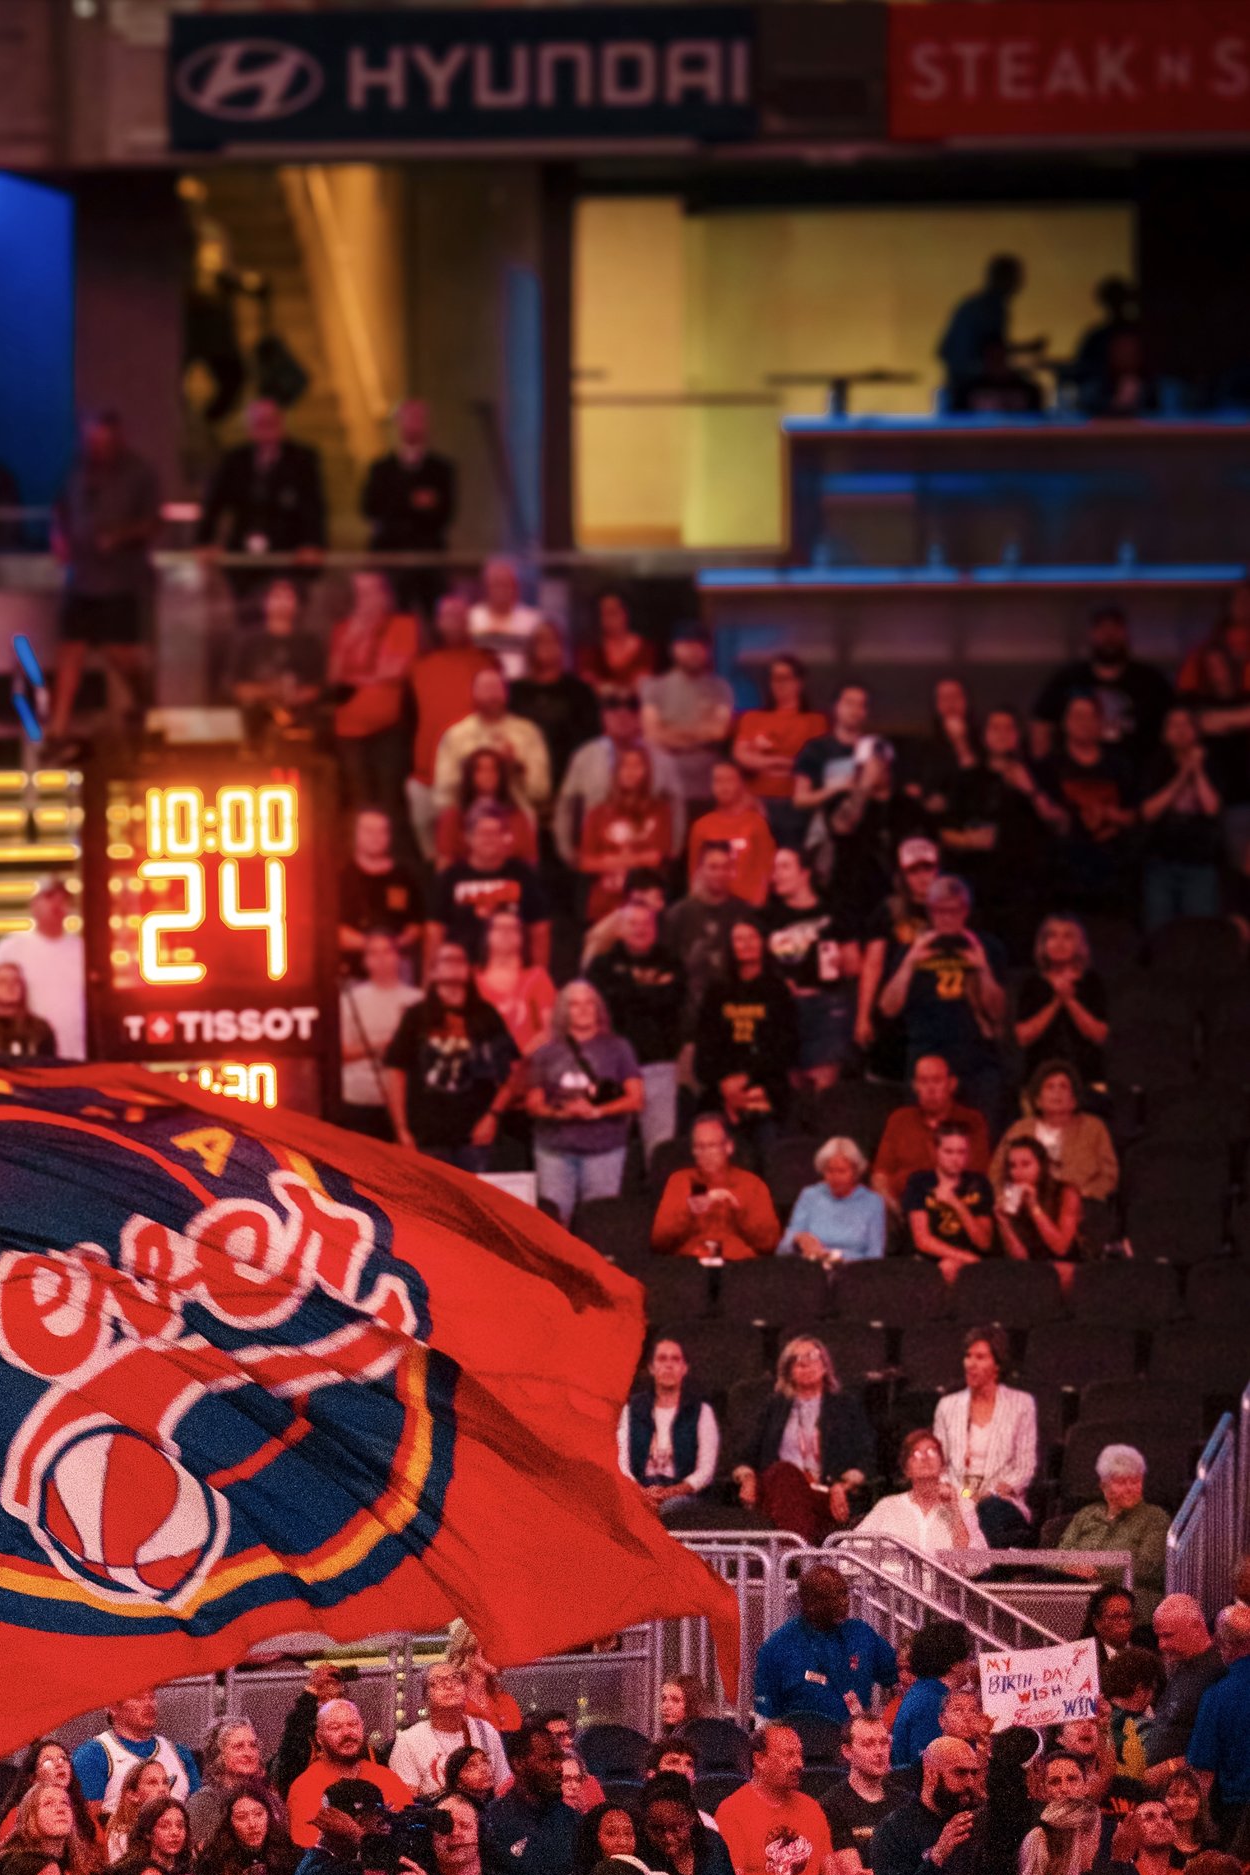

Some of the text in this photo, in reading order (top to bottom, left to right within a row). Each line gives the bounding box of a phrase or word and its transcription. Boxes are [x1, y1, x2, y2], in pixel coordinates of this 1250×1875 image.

[351, 40, 748, 110] HYUNDAI
[910, 40, 1139, 101] STEAK
[146, 785, 300, 859] 10:00
[137, 856, 288, 986] 24
[175, 1006, 319, 1043] TISSOT
[986, 1657, 1012, 1673] MY
[1078, 1675, 1093, 1693] A
[1061, 1696, 1097, 1719] WIN
